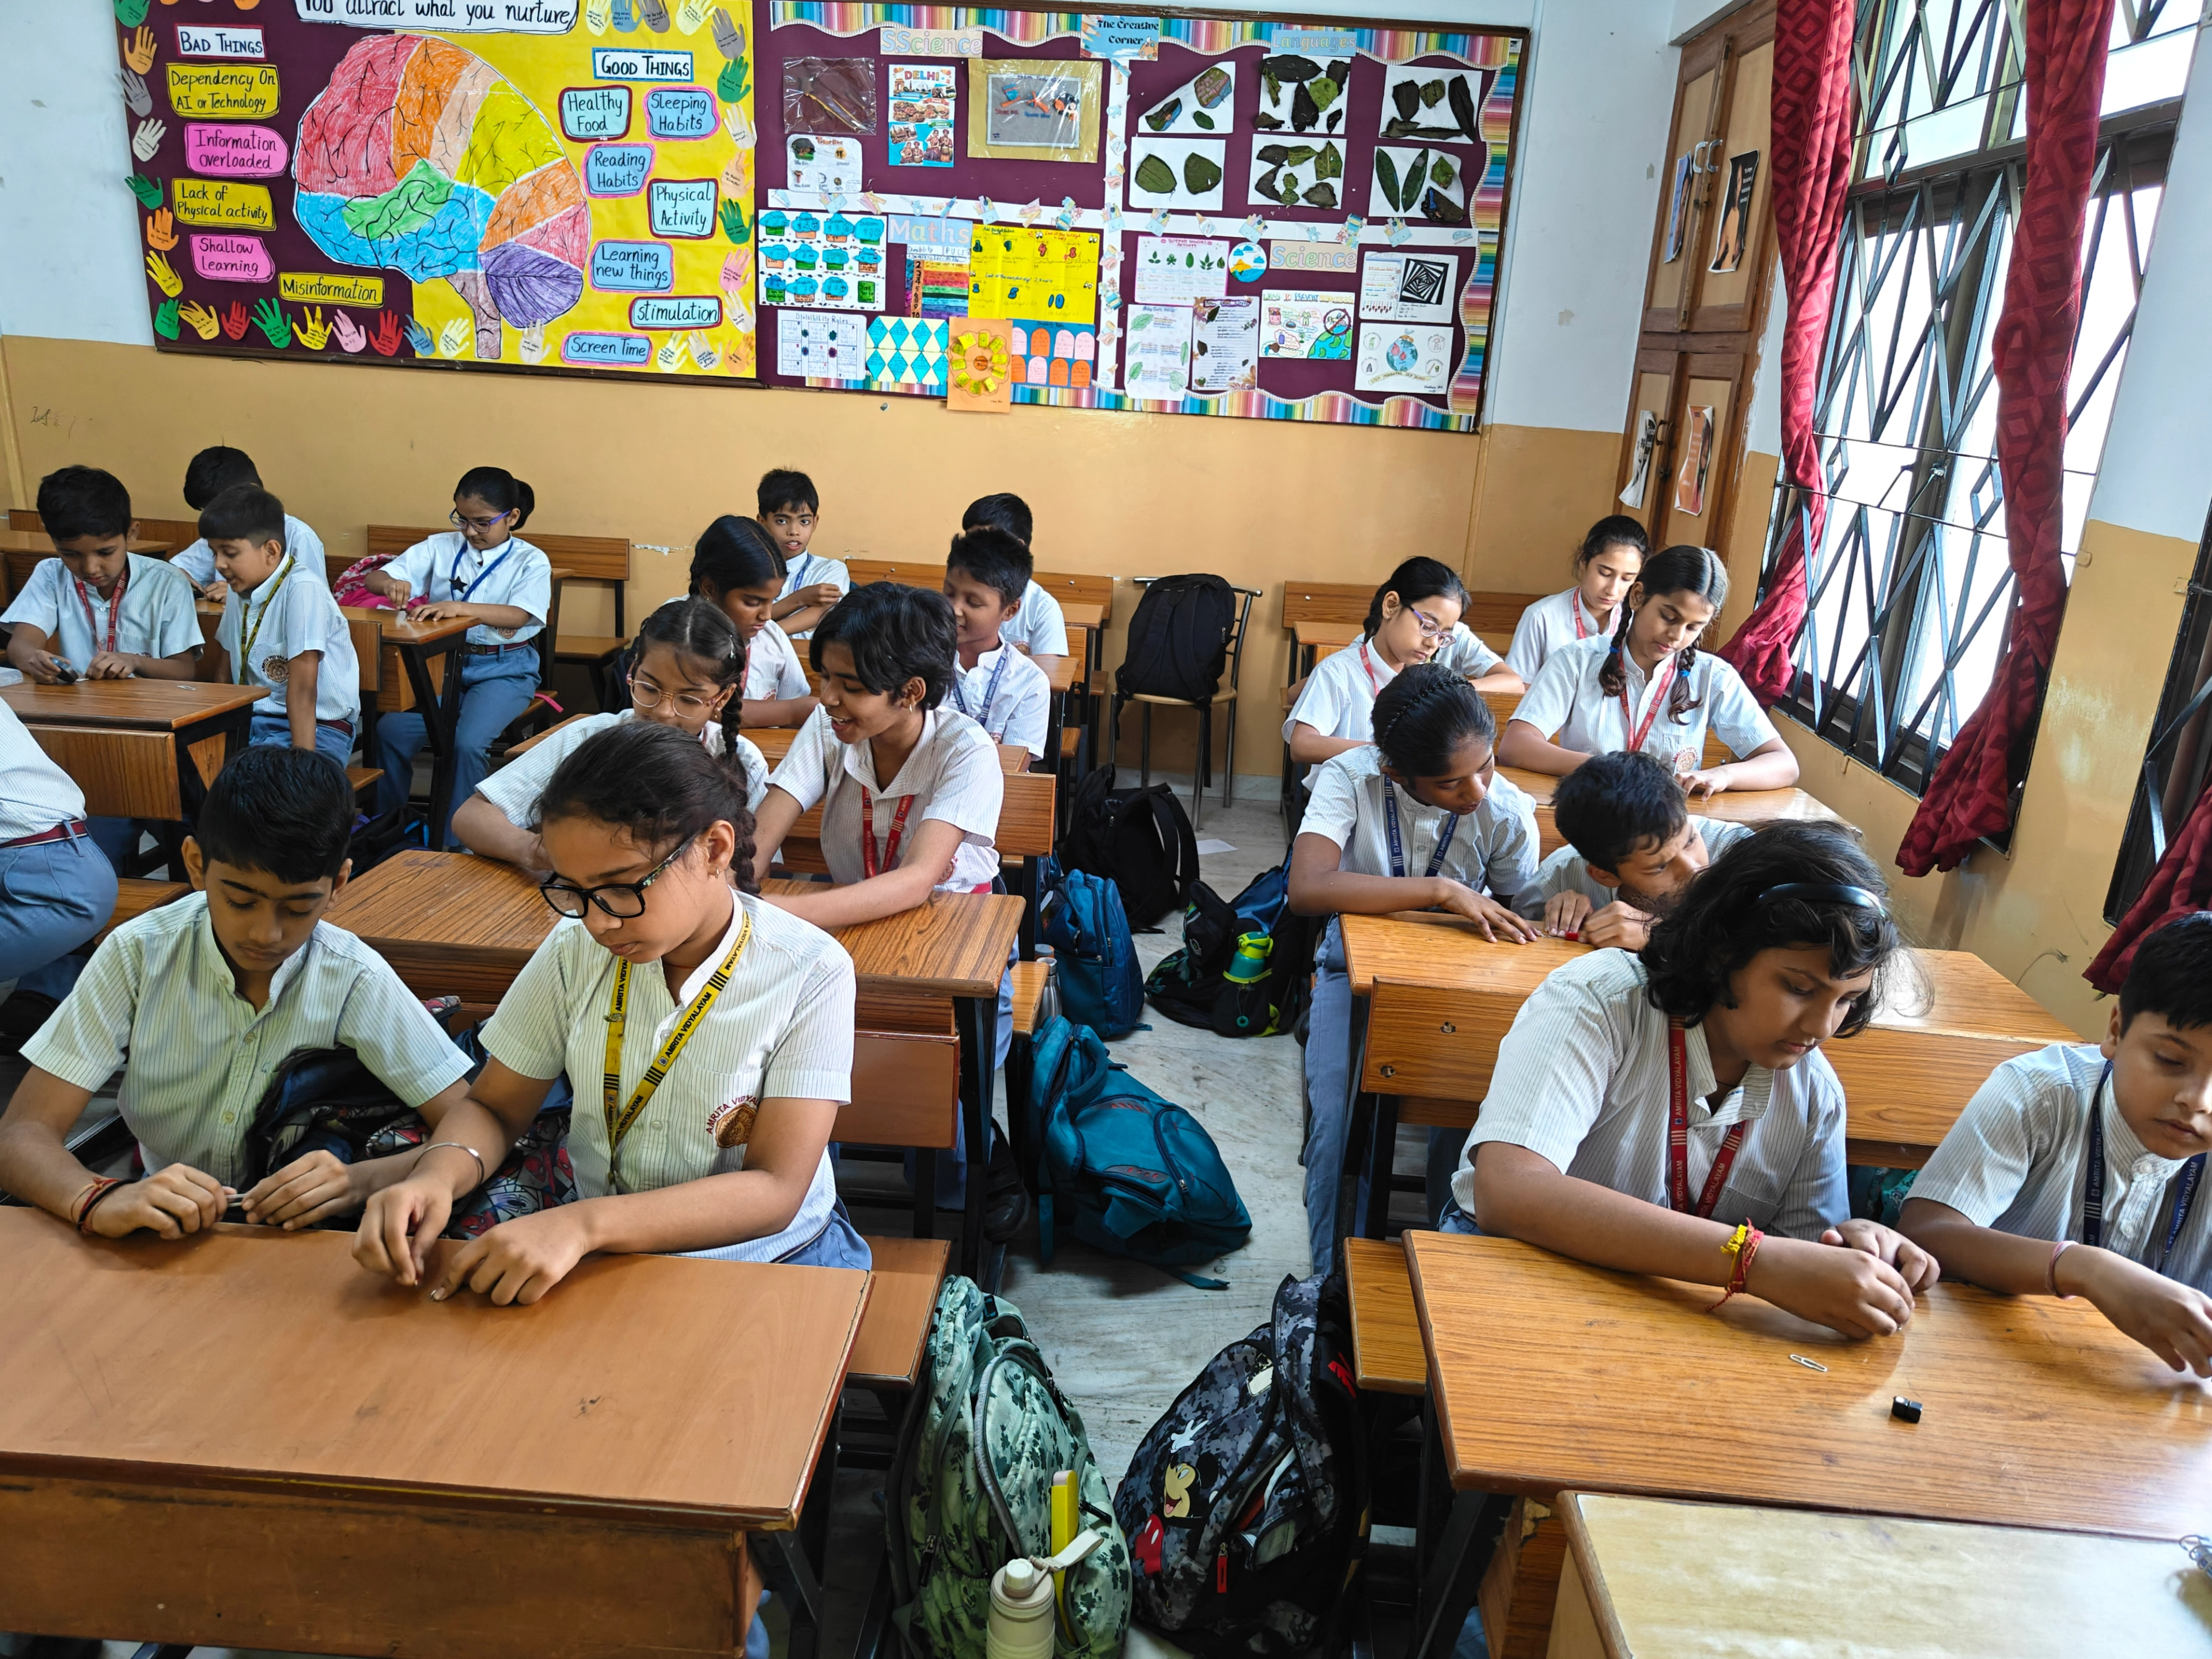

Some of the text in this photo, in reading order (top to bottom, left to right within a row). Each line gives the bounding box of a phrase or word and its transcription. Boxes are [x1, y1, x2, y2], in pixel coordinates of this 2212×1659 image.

[467, 2, 496, 26] you
[505, 2, 570, 25] nurture
[1097, 20, 1160, 31] The Creative
[180, 31, 263, 54] BAD THINGS
[1108, 35, 1144, 46] Corner
[1272, 33, 1357, 52] Languages
[601, 54, 690, 77] GOOD THINGS
[904, 70, 940, 81] DELHI
[172, 69, 276, 93] Dependency On
[176, 92, 267, 113] AI or Technology
[567, 90, 623, 118] Healthy
[650, 93, 707, 116] Sleeping
[577, 115, 609, 132] Food
[658, 116, 703, 131] Habits
[194, 128, 277, 152] Information
[595, 151, 646, 172] Reading
[597, 172, 639, 188] Habits
[181, 183, 229, 202] Lack of
[656, 180, 712, 209] Physical
[177, 202, 268, 225] Physical activity
[661, 207, 707, 232] Activity
[889, 218, 971, 245] Maths
[199, 238, 254, 255] Shallow
[601, 245, 659, 268] Learning
[1270, 246, 1357, 268] Science
[596, 263, 669, 288] new things
[282, 276, 378, 302] Misinformation
[573, 337, 617, 354] Screen
[620, 338, 646, 357] Time
[1388, 800, 1397, 829] VIDYALAYAM
[1440, 835, 1450, 851] AMRITA
[724, 930, 748, 971] VIDYALAYAM
[615, 959, 628, 1012] AMRITA VIDYA
[664, 991, 713, 1058] AMRITA VIDYALAYAM
[1673, 1046, 1681, 1089] VIDYALAYAM
[618, 1094, 644, 1130] VIDYALAYAM
[706, 1094, 759, 1135] AMRITA VIDYAL
[1706, 1162, 1726, 1205] VIDYALAYAM
[2093, 1158, 2101, 1188] AMRITA
[2173, 1161, 2199, 1238] AMRITA VIDYALAYAM
